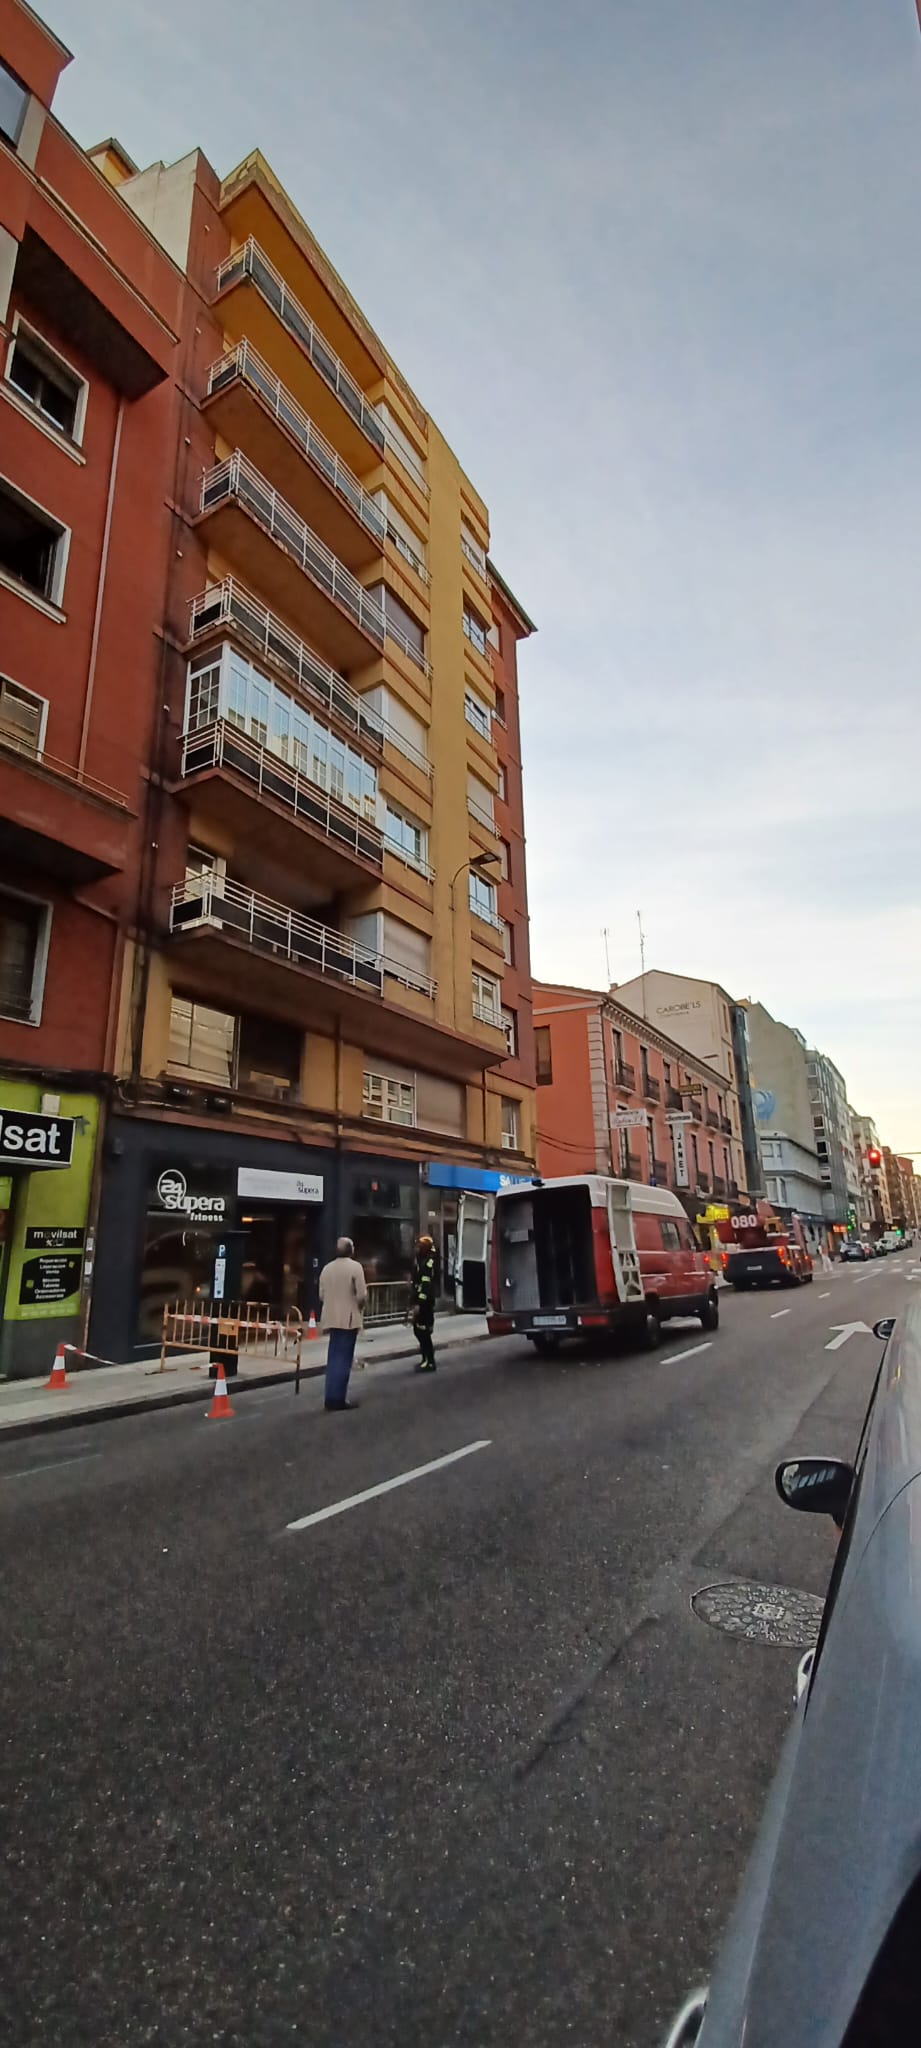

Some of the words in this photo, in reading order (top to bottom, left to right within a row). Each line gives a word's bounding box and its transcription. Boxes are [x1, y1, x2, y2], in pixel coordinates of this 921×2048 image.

[676, 1132, 684, 1177] JANET
[161, 1179, 183, 1194] 24
[190, 1213, 224, 1222] fitness
[731, 1215, 757, 1229] 080
[33, 1229, 77, 1239] movilsat
